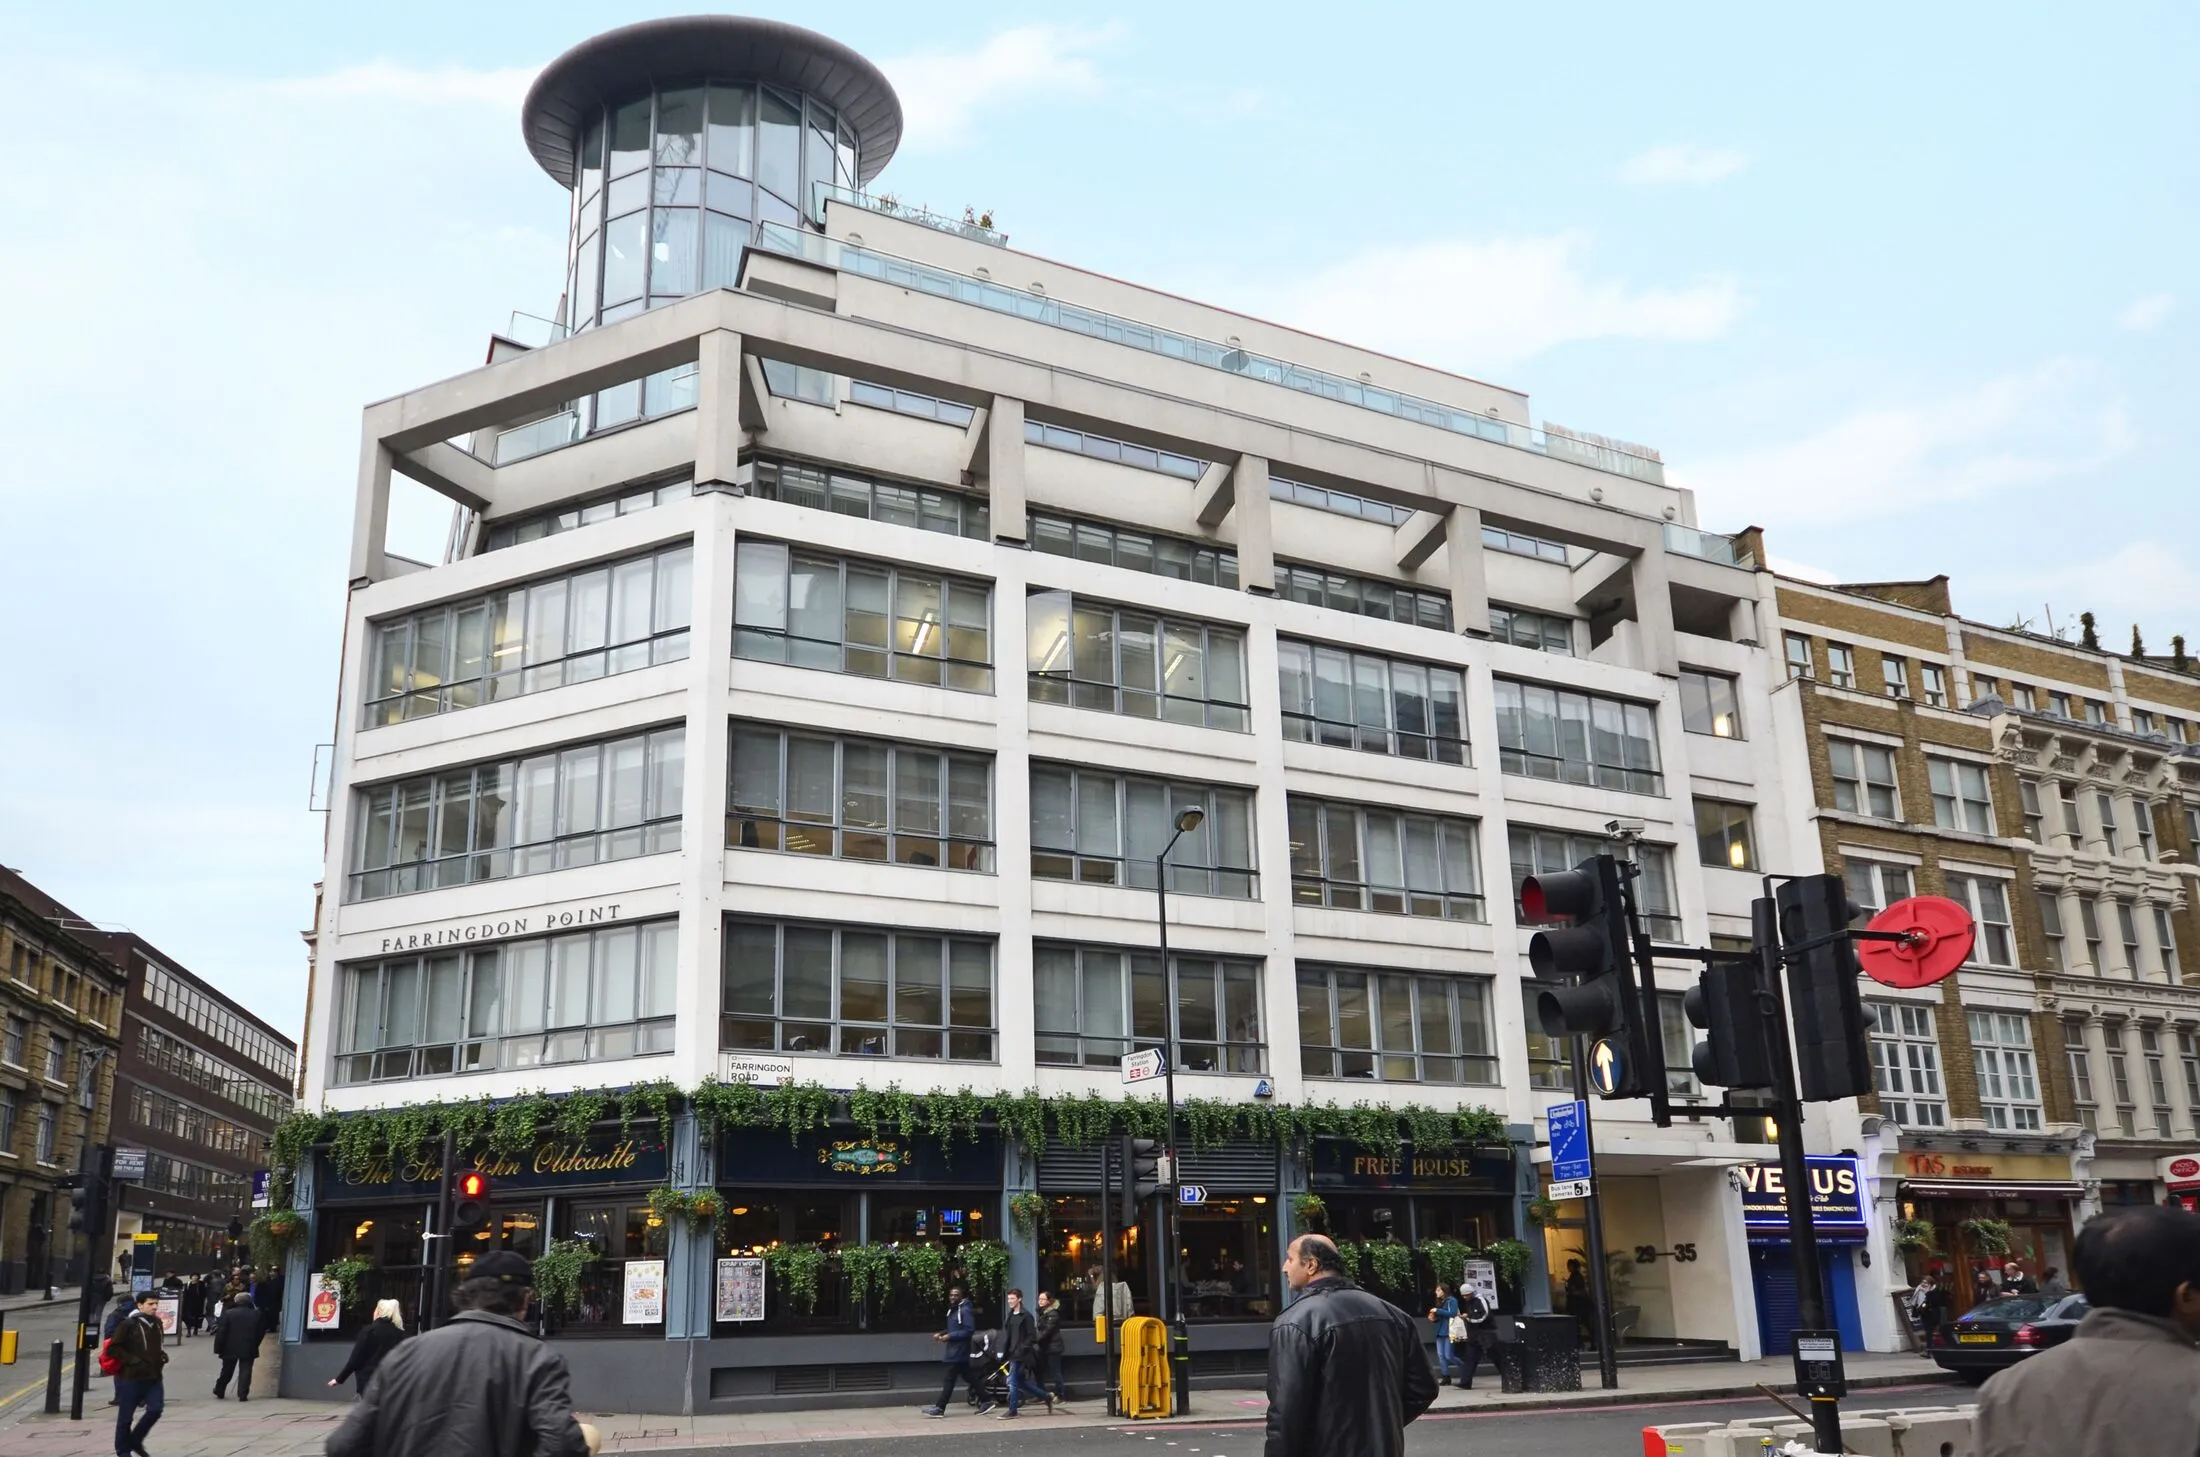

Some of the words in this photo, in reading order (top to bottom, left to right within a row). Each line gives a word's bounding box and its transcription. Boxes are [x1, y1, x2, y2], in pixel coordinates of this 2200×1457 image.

[382, 918, 528, 952] FARRINGDON
[547, 904, 621, 928] POINT
[1127, 1052, 1152, 1061] Farringdon
[731, 1062, 791, 1073] FARRINGDON
[731, 1072, 759, 1082] ROAD
[345, 1153, 394, 1185] The
[400, 1152, 444, 1183] Sir
[473, 1149, 521, 1176] John
[533, 1139, 637, 1174] Oldcastle
[1354, 1157, 1402, 1175] FREE
[1412, 1159, 1471, 1176] HOUSE
[1739, 1167, 1857, 1195] VEUS
[1184, 1187, 1194, 1201] P
